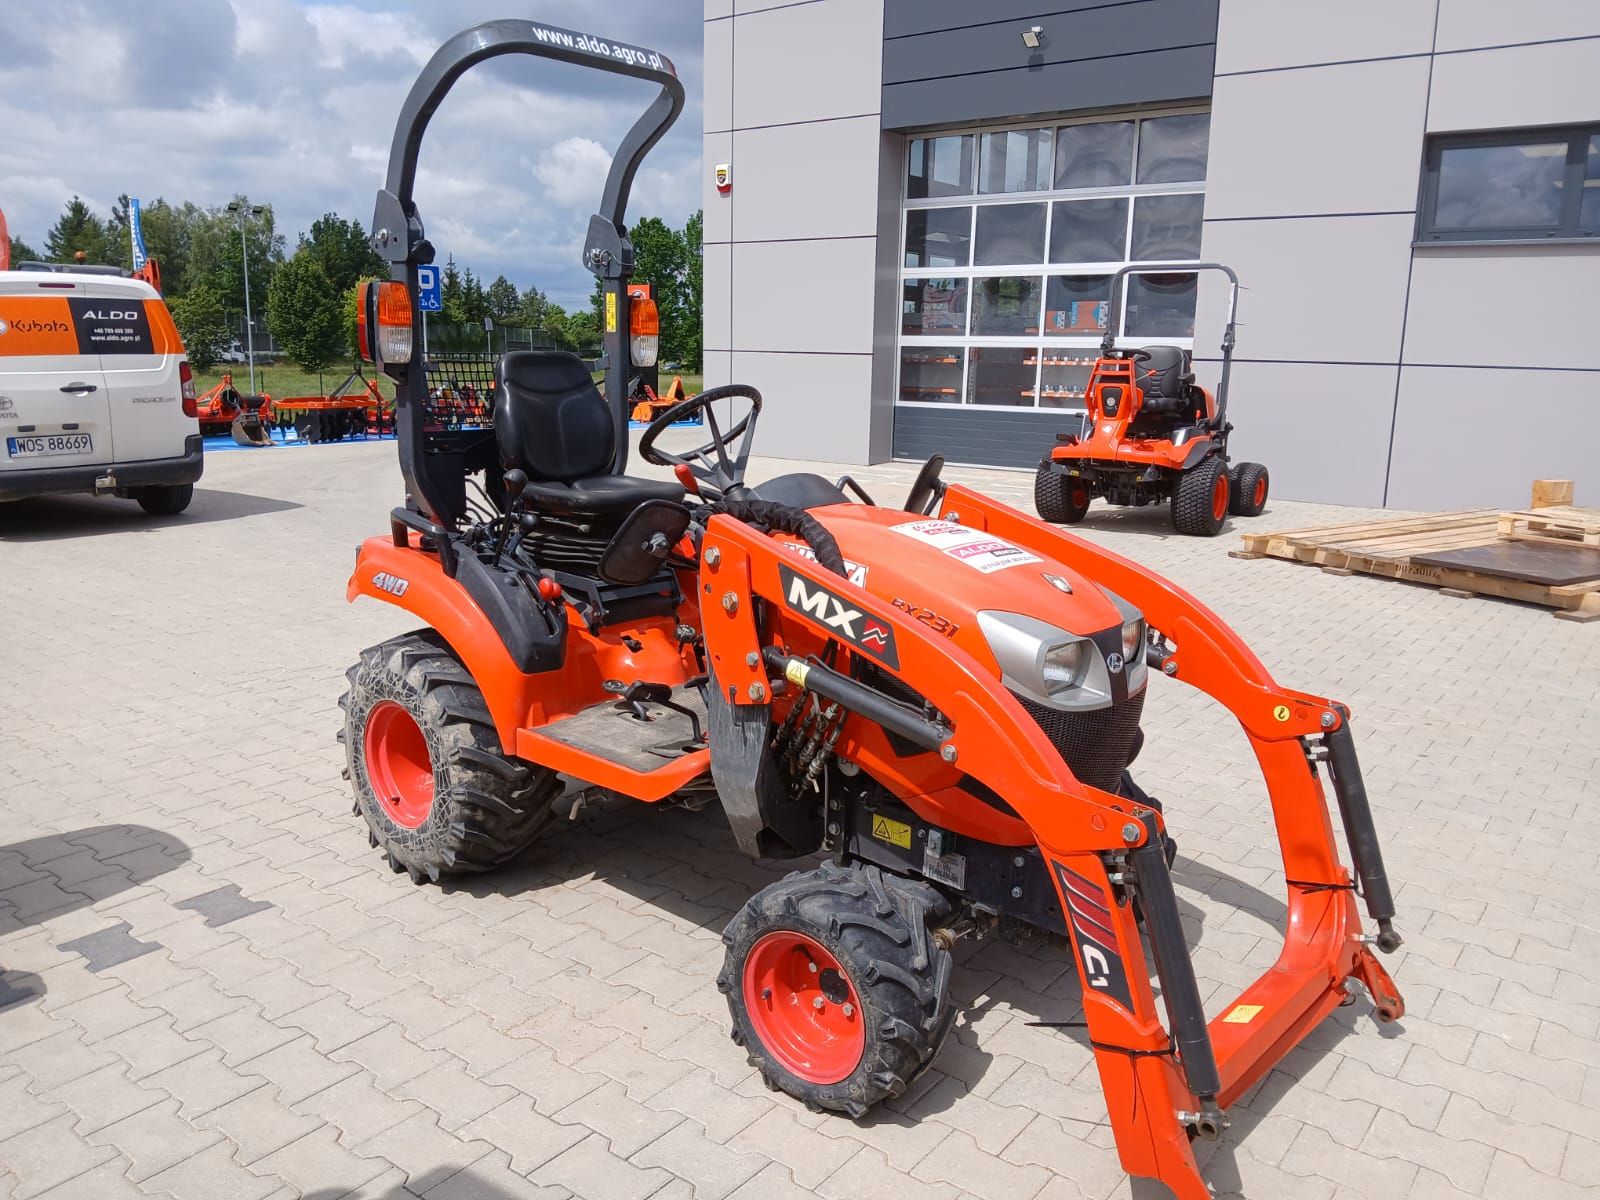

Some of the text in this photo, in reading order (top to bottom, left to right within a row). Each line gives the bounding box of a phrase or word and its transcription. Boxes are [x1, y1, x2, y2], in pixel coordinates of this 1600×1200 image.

[532, 26, 664, 70] www.aldo.agro.pl
[82, 310, 138, 320] ALDO
[10, 319, 69, 333] Kubota
[17, 438, 45, 453] WOS
[48, 436, 89, 450] 88669
[959, 542, 1004, 558] ALDO
[372, 571, 409, 597] 4WD
[788, 576, 863, 640] MX
[1082, 944, 1110, 987] C1
